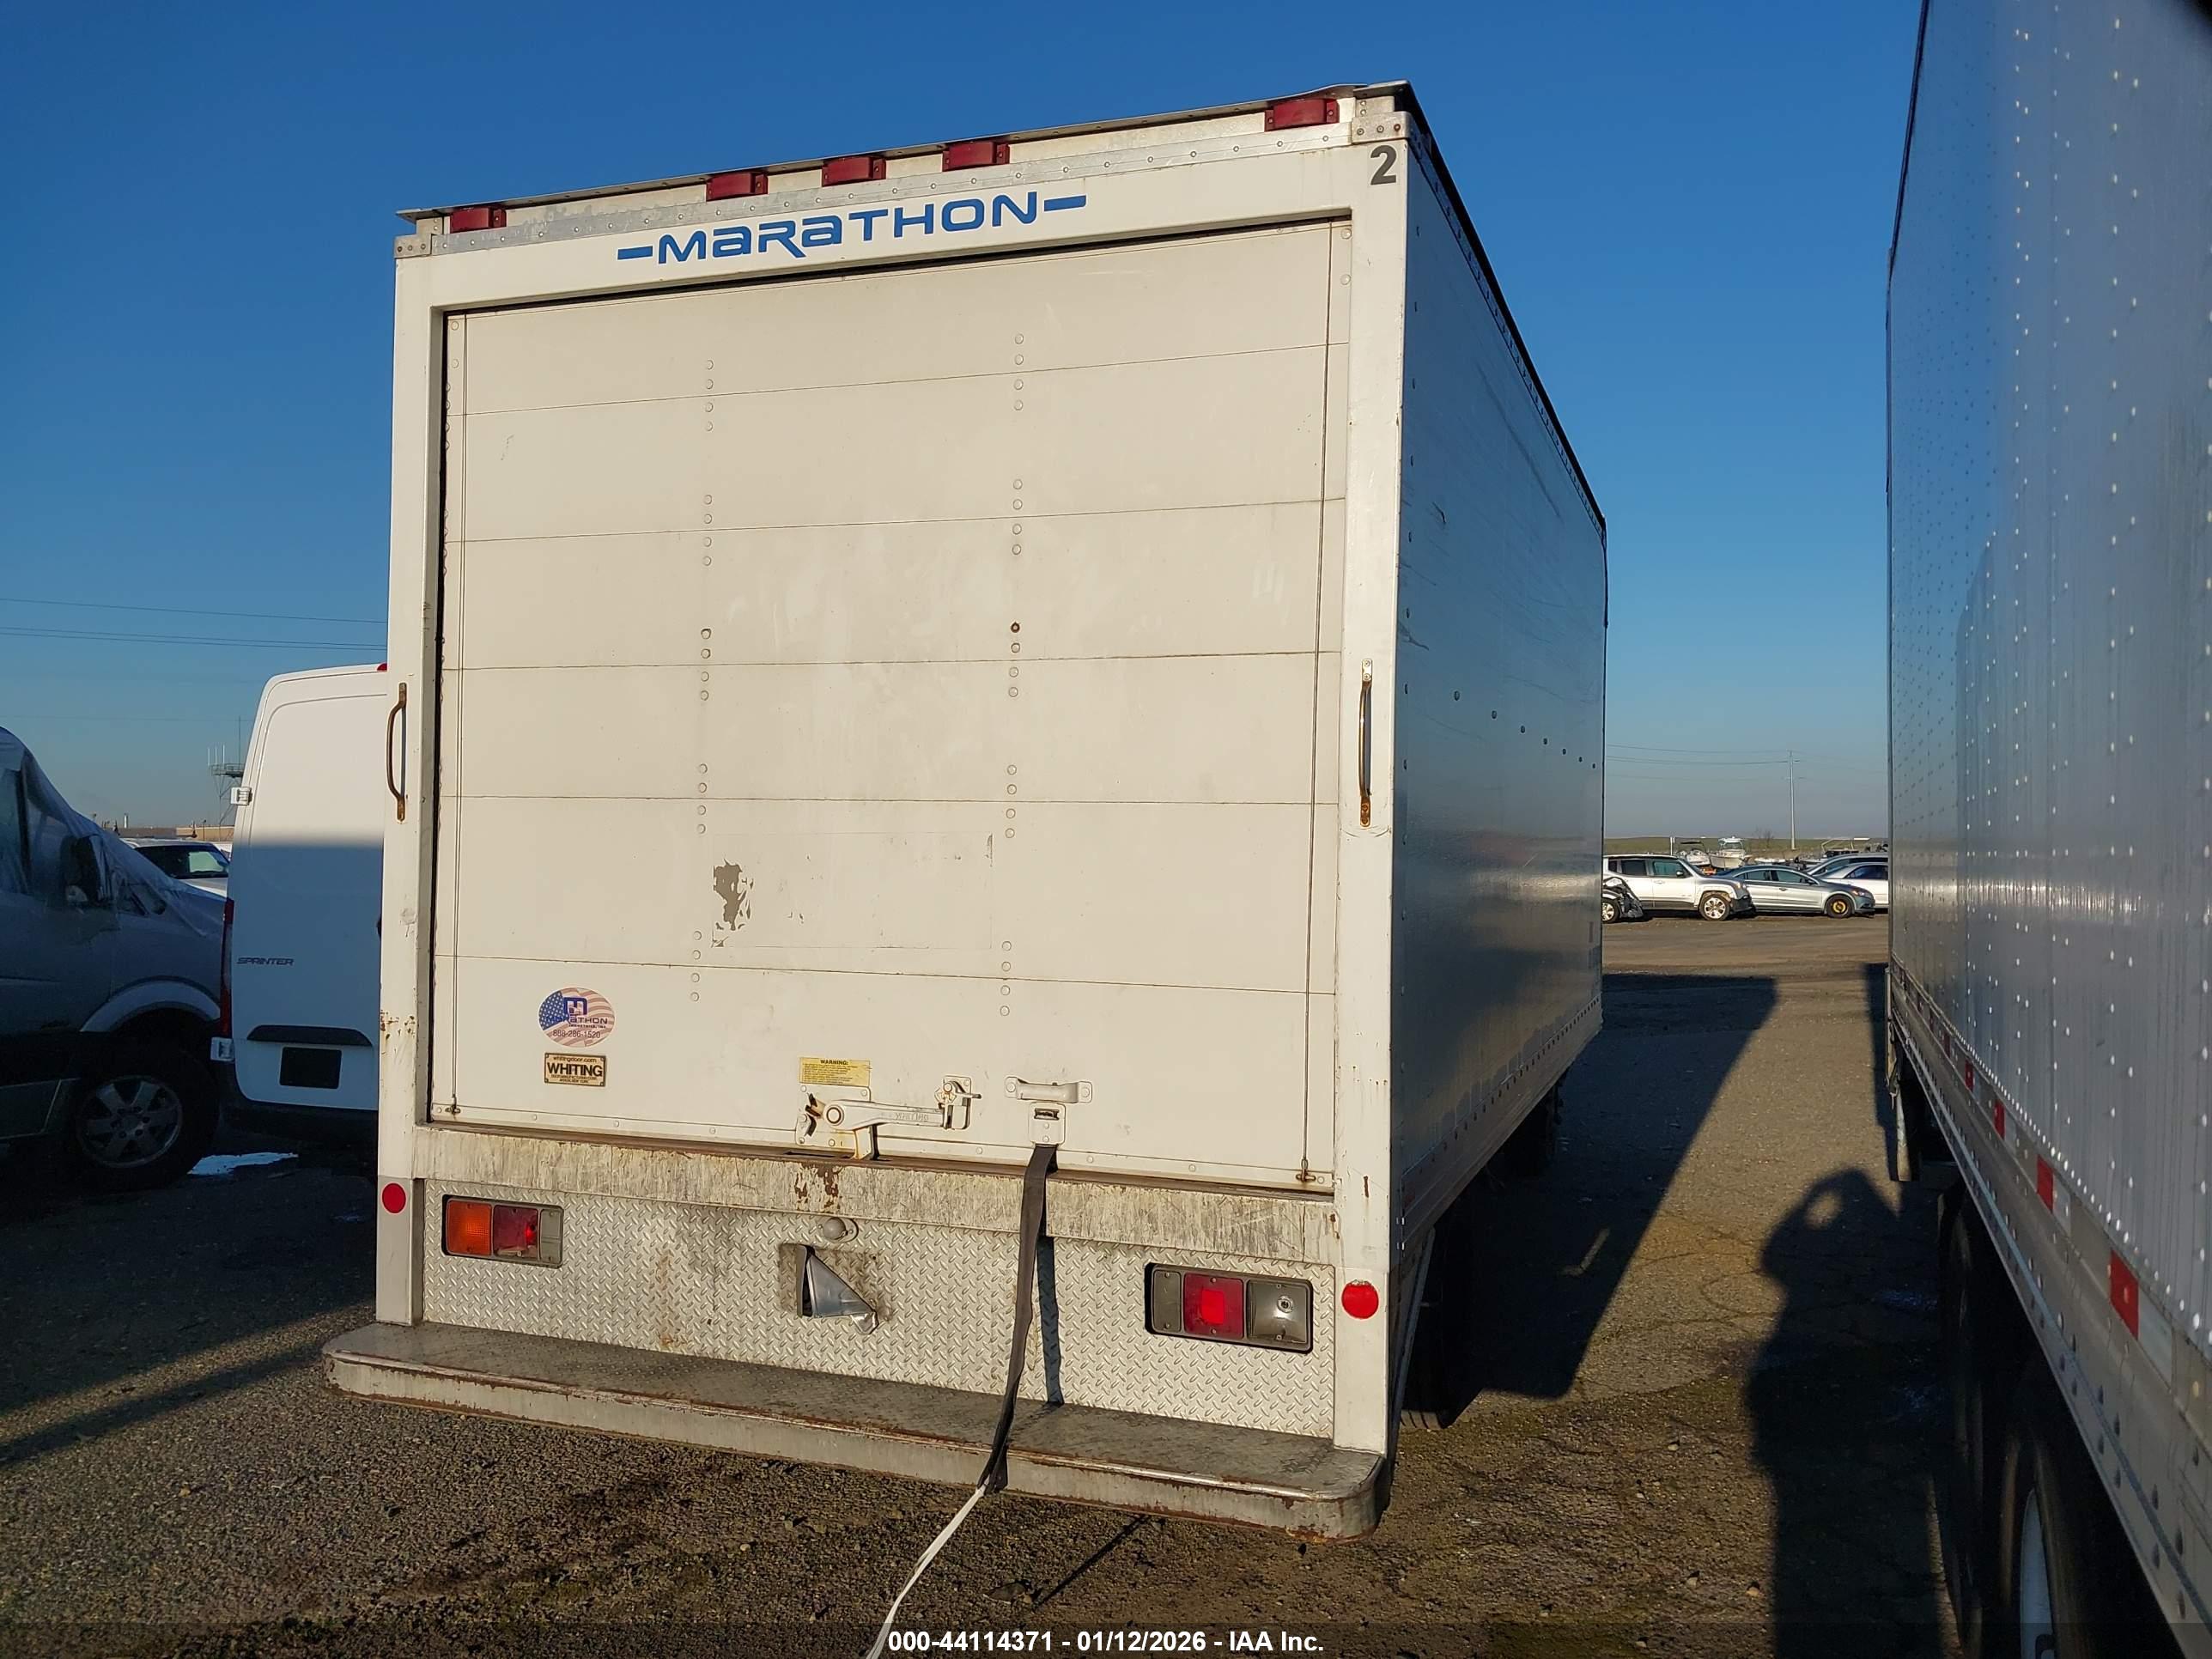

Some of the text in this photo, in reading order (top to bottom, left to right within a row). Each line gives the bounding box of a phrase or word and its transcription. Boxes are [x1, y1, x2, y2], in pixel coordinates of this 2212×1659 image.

[1370, 144, 1397, 185] 2
[236, 957, 295, 967] SPRINTER
[547, 1062, 603, 1077] WHITING
